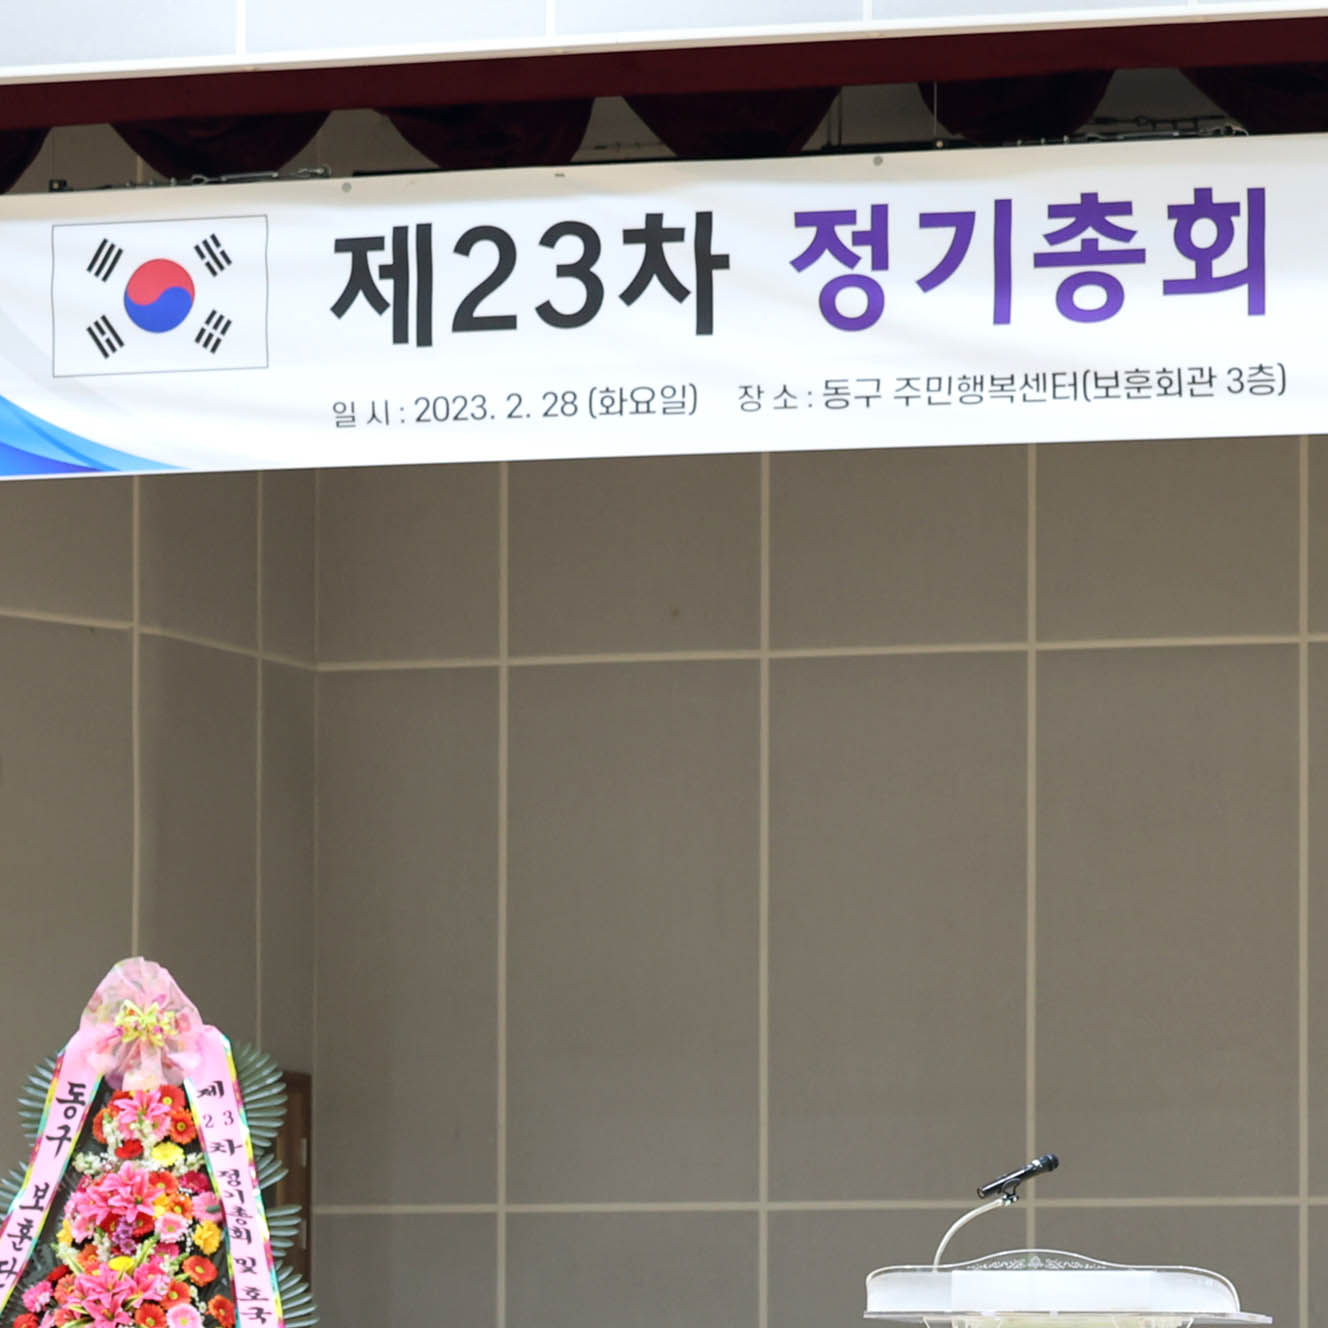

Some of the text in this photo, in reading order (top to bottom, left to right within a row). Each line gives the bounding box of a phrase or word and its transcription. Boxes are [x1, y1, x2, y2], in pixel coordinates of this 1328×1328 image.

[329, 210, 730, 348] 제23차
[790, 186, 1266, 333] 정기총회
[541, 391, 579, 418] 28
[588, 382, 698, 419] (화요일)
[822, 377, 882, 410] 동구
[1227, 362, 1287, 397] 3층)
[46, 1081, 87, 1157] 동구
[218, 1168, 253, 1244] 정기총회
[234, 1256, 257, 1276] 및
